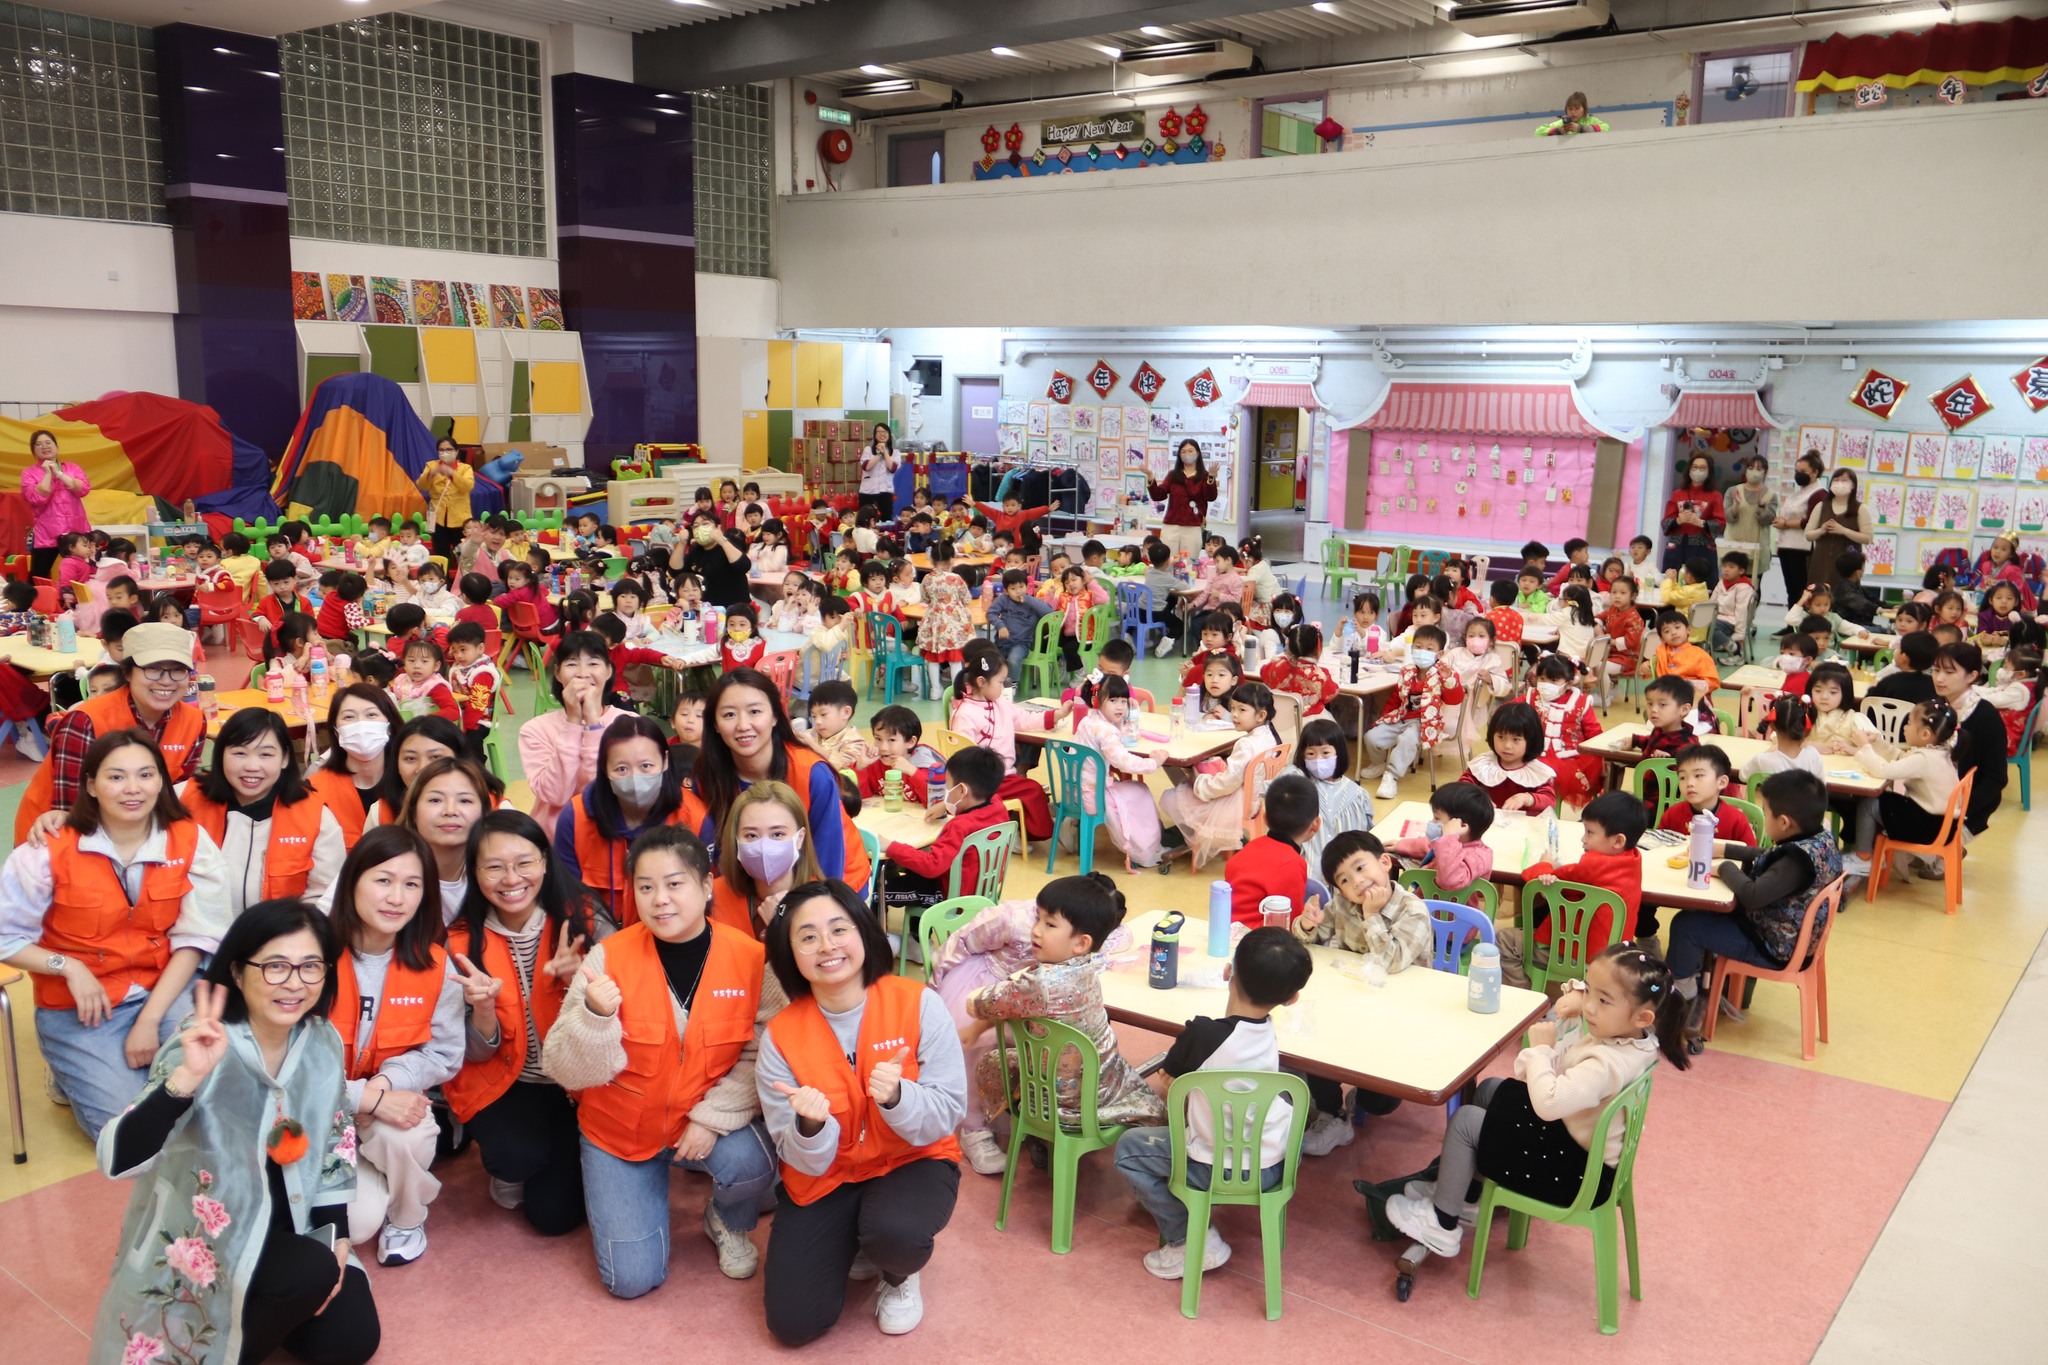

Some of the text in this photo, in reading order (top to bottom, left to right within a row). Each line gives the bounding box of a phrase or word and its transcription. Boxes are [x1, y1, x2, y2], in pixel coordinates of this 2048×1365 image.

[1048, 119, 1133, 140] Happy New Year
